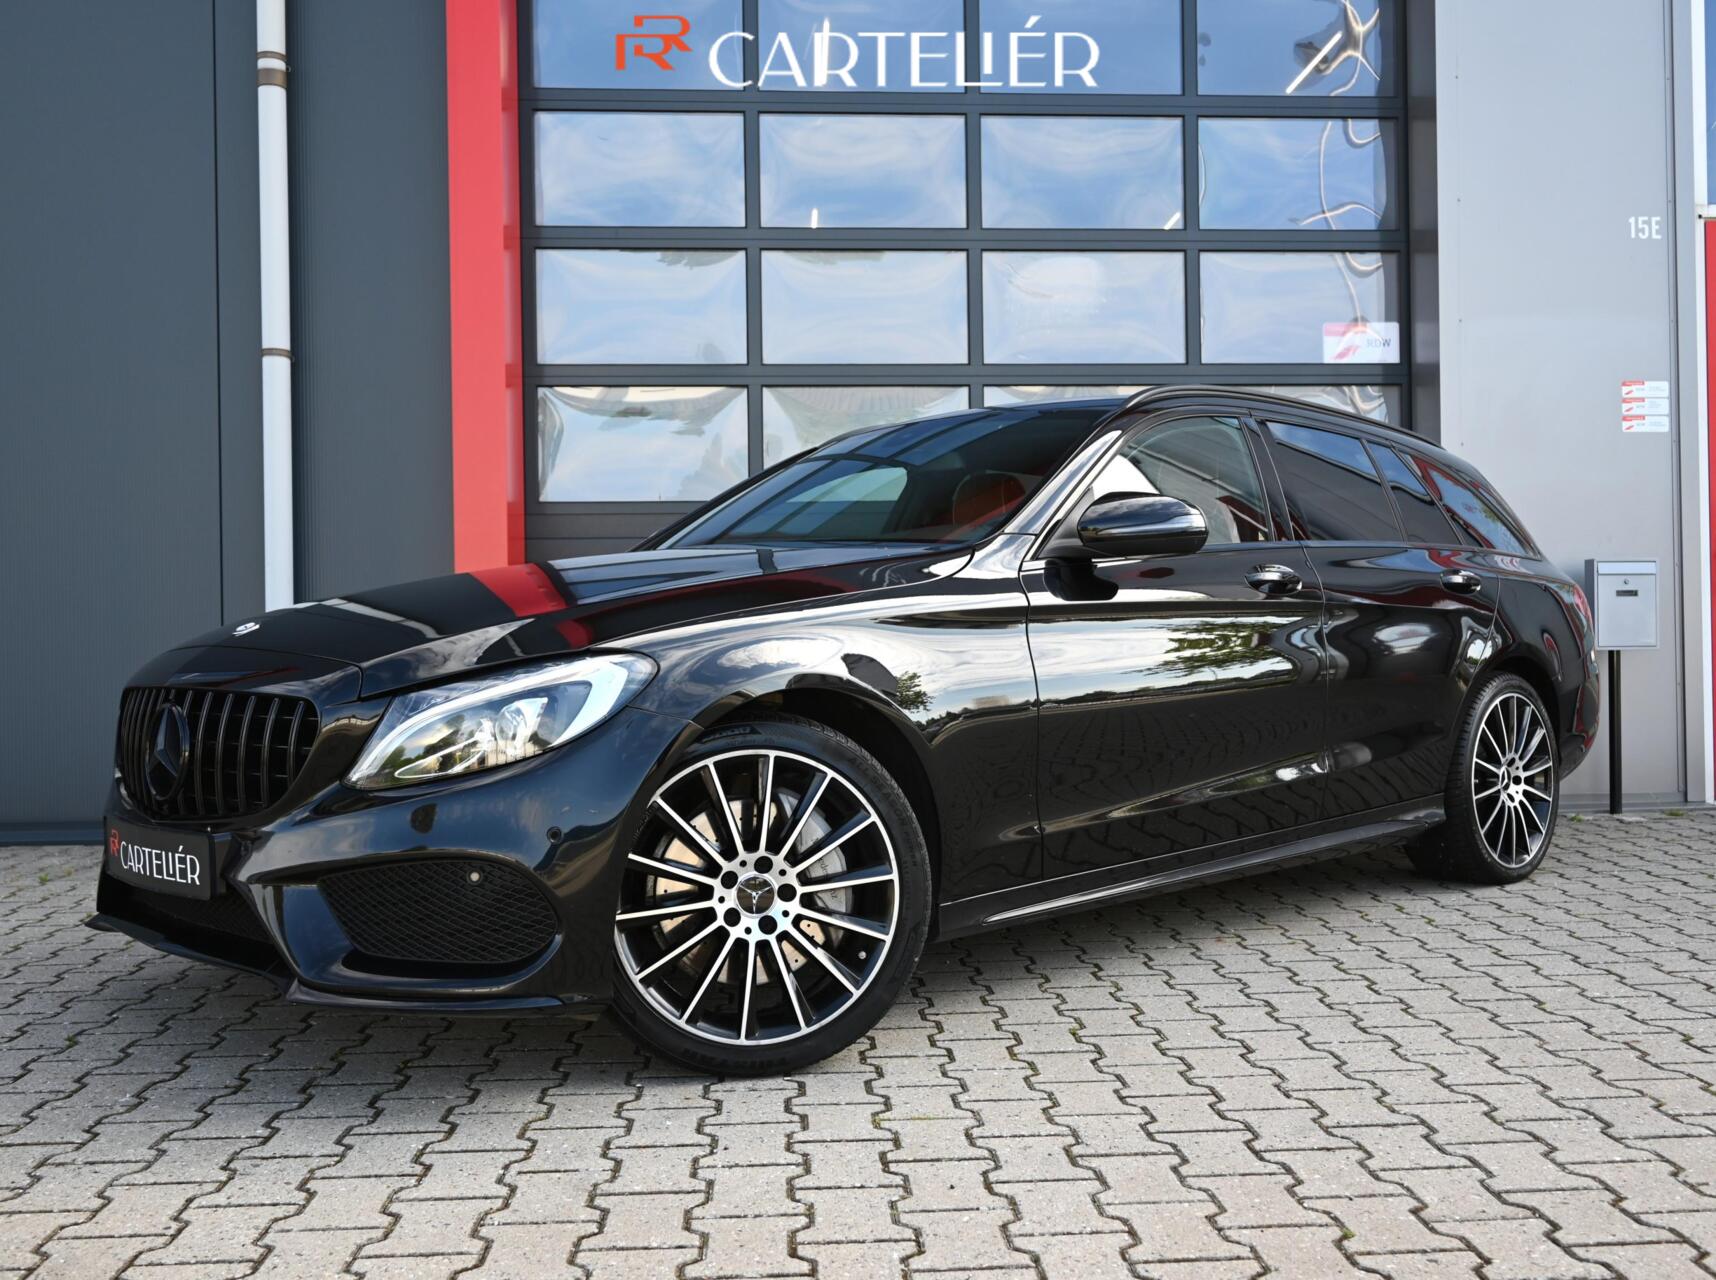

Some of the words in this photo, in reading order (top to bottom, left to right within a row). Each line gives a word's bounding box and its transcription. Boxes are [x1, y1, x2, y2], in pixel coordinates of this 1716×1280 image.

[708, 16, 1101, 89] CARTELIÉR
[1628, 216, 1662, 239] 15E
[120, 841, 201, 886] CARTELIÉR
